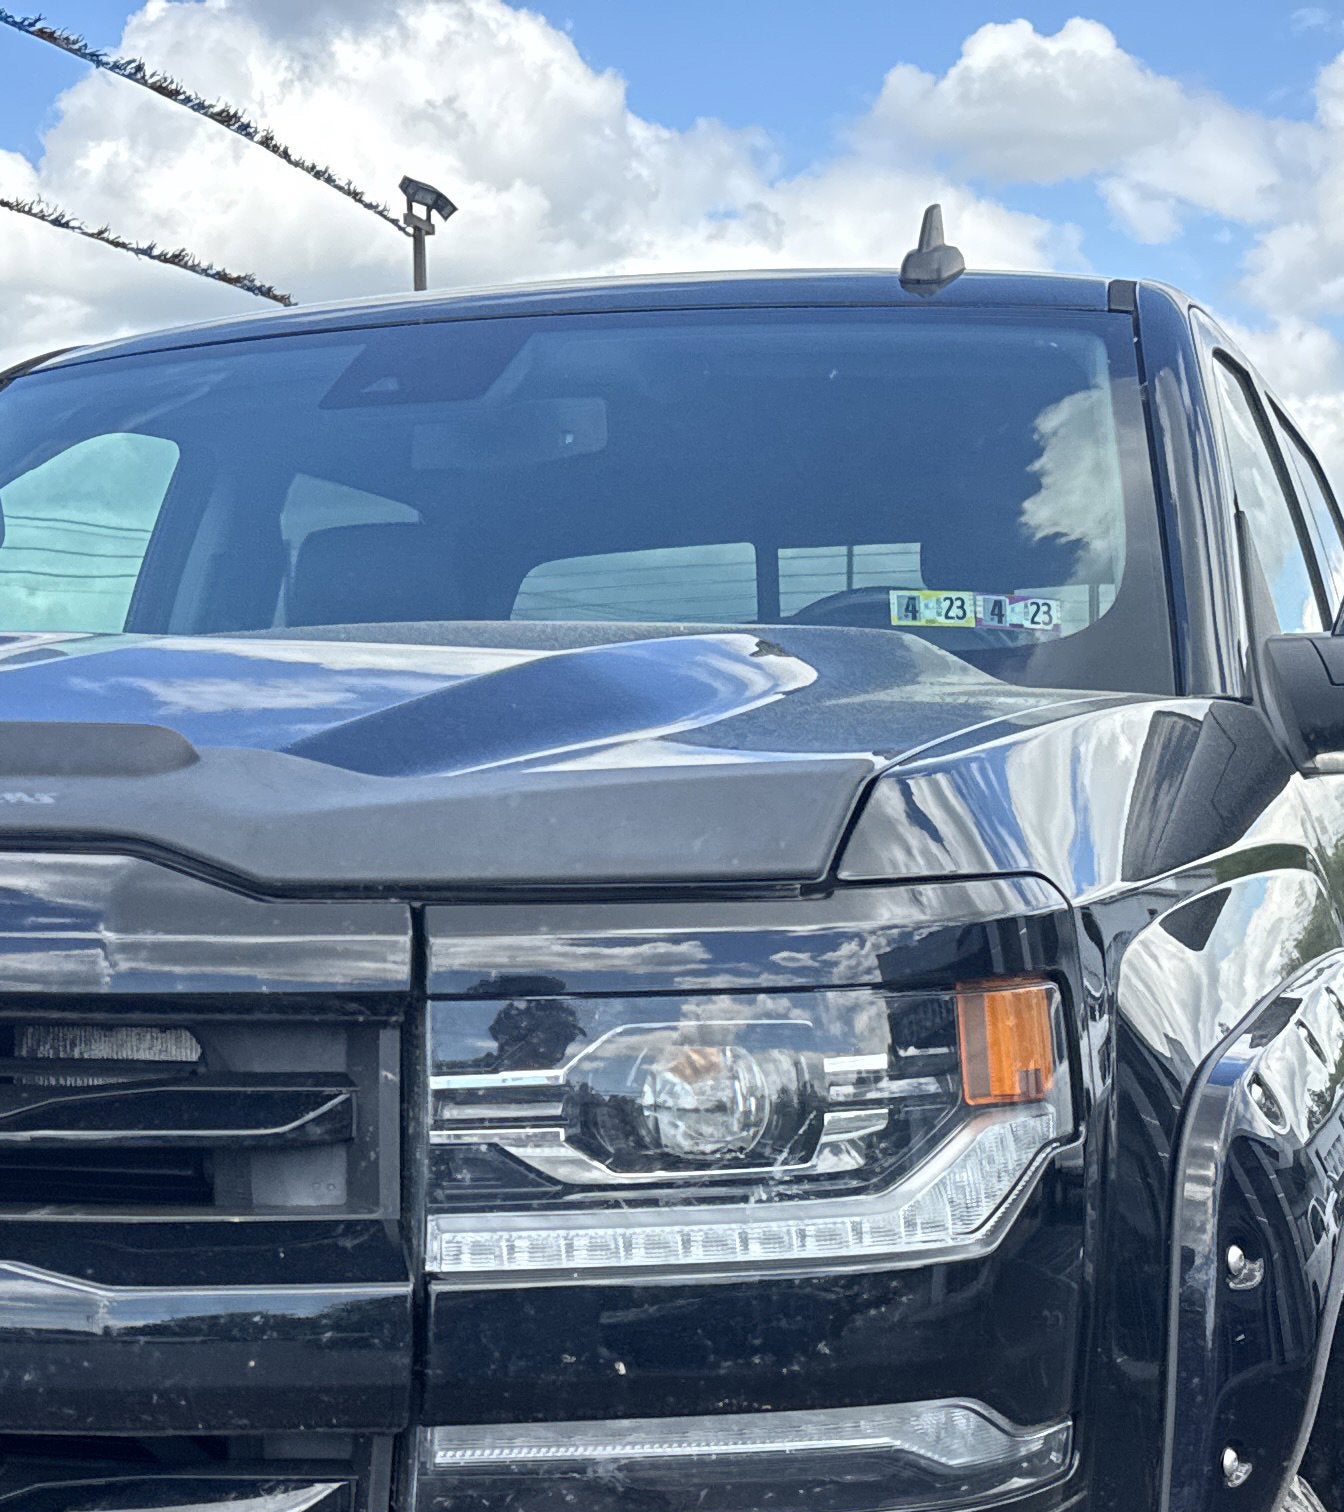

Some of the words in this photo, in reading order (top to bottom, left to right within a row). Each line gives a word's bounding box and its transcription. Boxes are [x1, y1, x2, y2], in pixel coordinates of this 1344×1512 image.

[904, 596, 919, 621] 4
[942, 597, 967, 621] 23
[990, 599, 1005, 625] 4
[1029, 602, 1053, 626] 23
